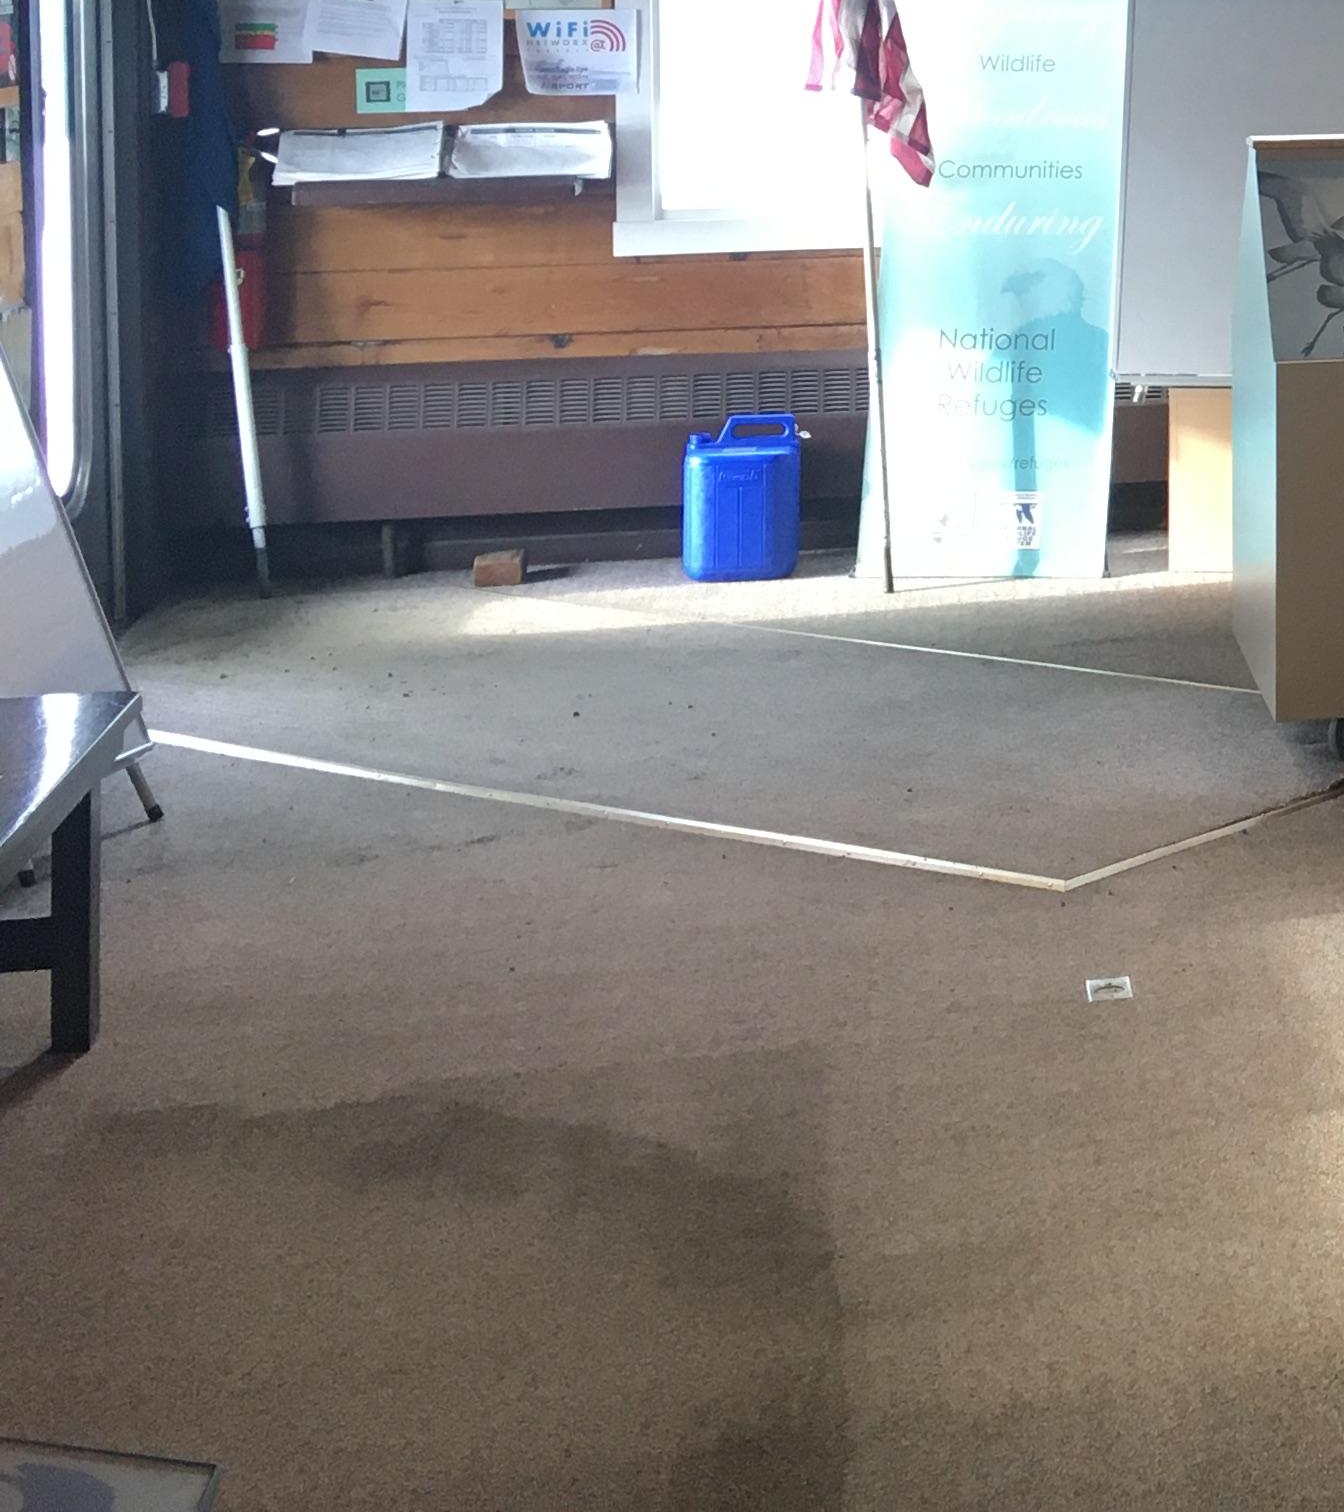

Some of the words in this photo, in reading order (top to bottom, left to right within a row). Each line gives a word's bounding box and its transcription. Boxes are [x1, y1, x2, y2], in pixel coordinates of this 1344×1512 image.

[526, 21, 589, 38] WiFi
[980, 54, 1056, 72] Wildlife
[939, 160, 1083, 179] Communities
[940, 328, 1056, 350] National
[948, 361, 1042, 383] Wildlife
[938, 395, 1047, 422] Refuges
